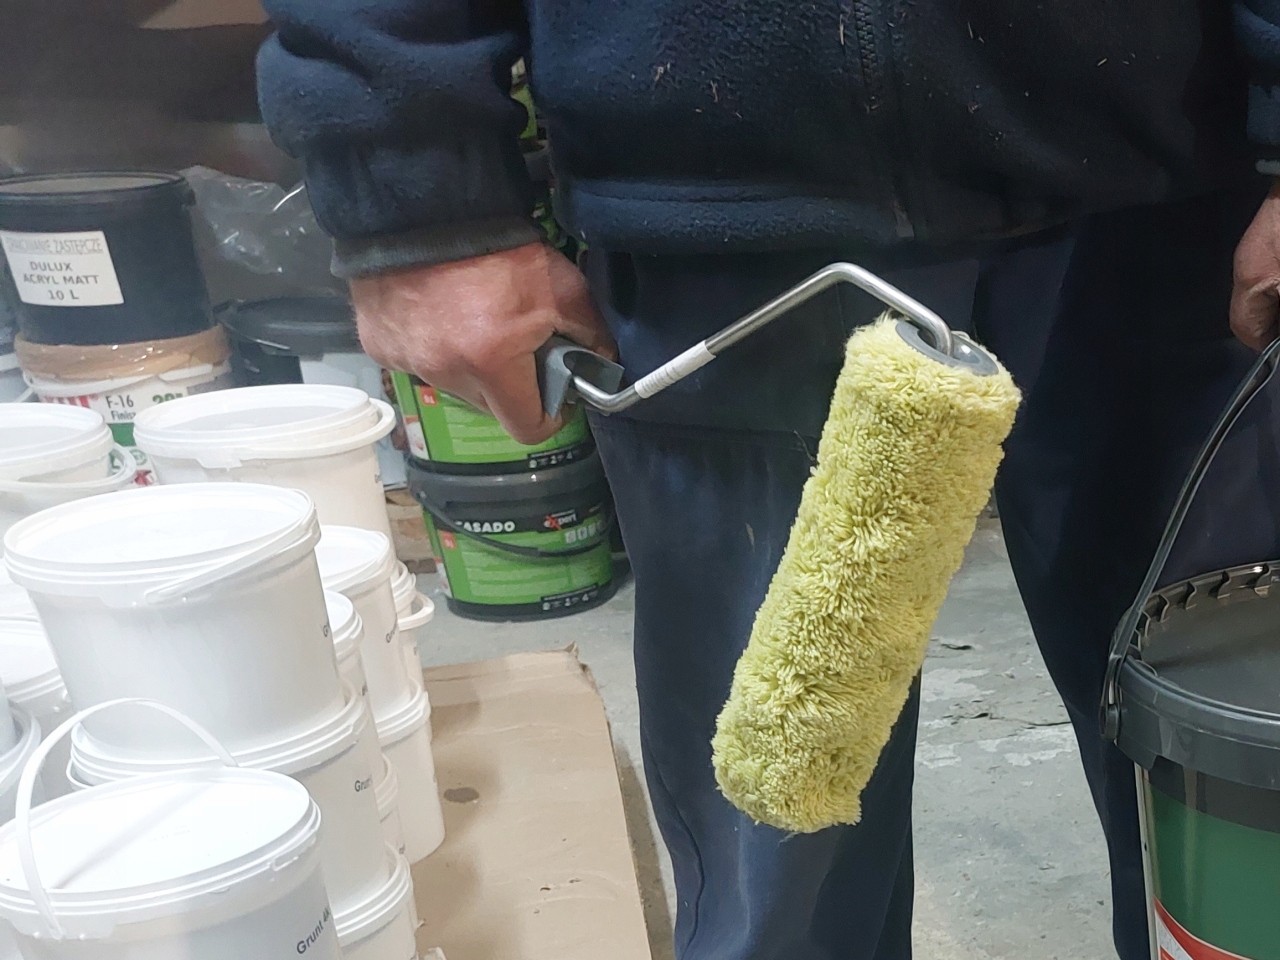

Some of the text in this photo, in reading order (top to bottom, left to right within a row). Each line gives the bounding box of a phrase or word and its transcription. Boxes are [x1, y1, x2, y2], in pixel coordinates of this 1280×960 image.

[29, 261, 73, 272] DULUX
[23, 273, 99, 285] ACRYL MATT
[48, 289, 79, 300] 10 L
[105, 394, 134, 409] F-16
[296, 920, 324, 955] Grunt
